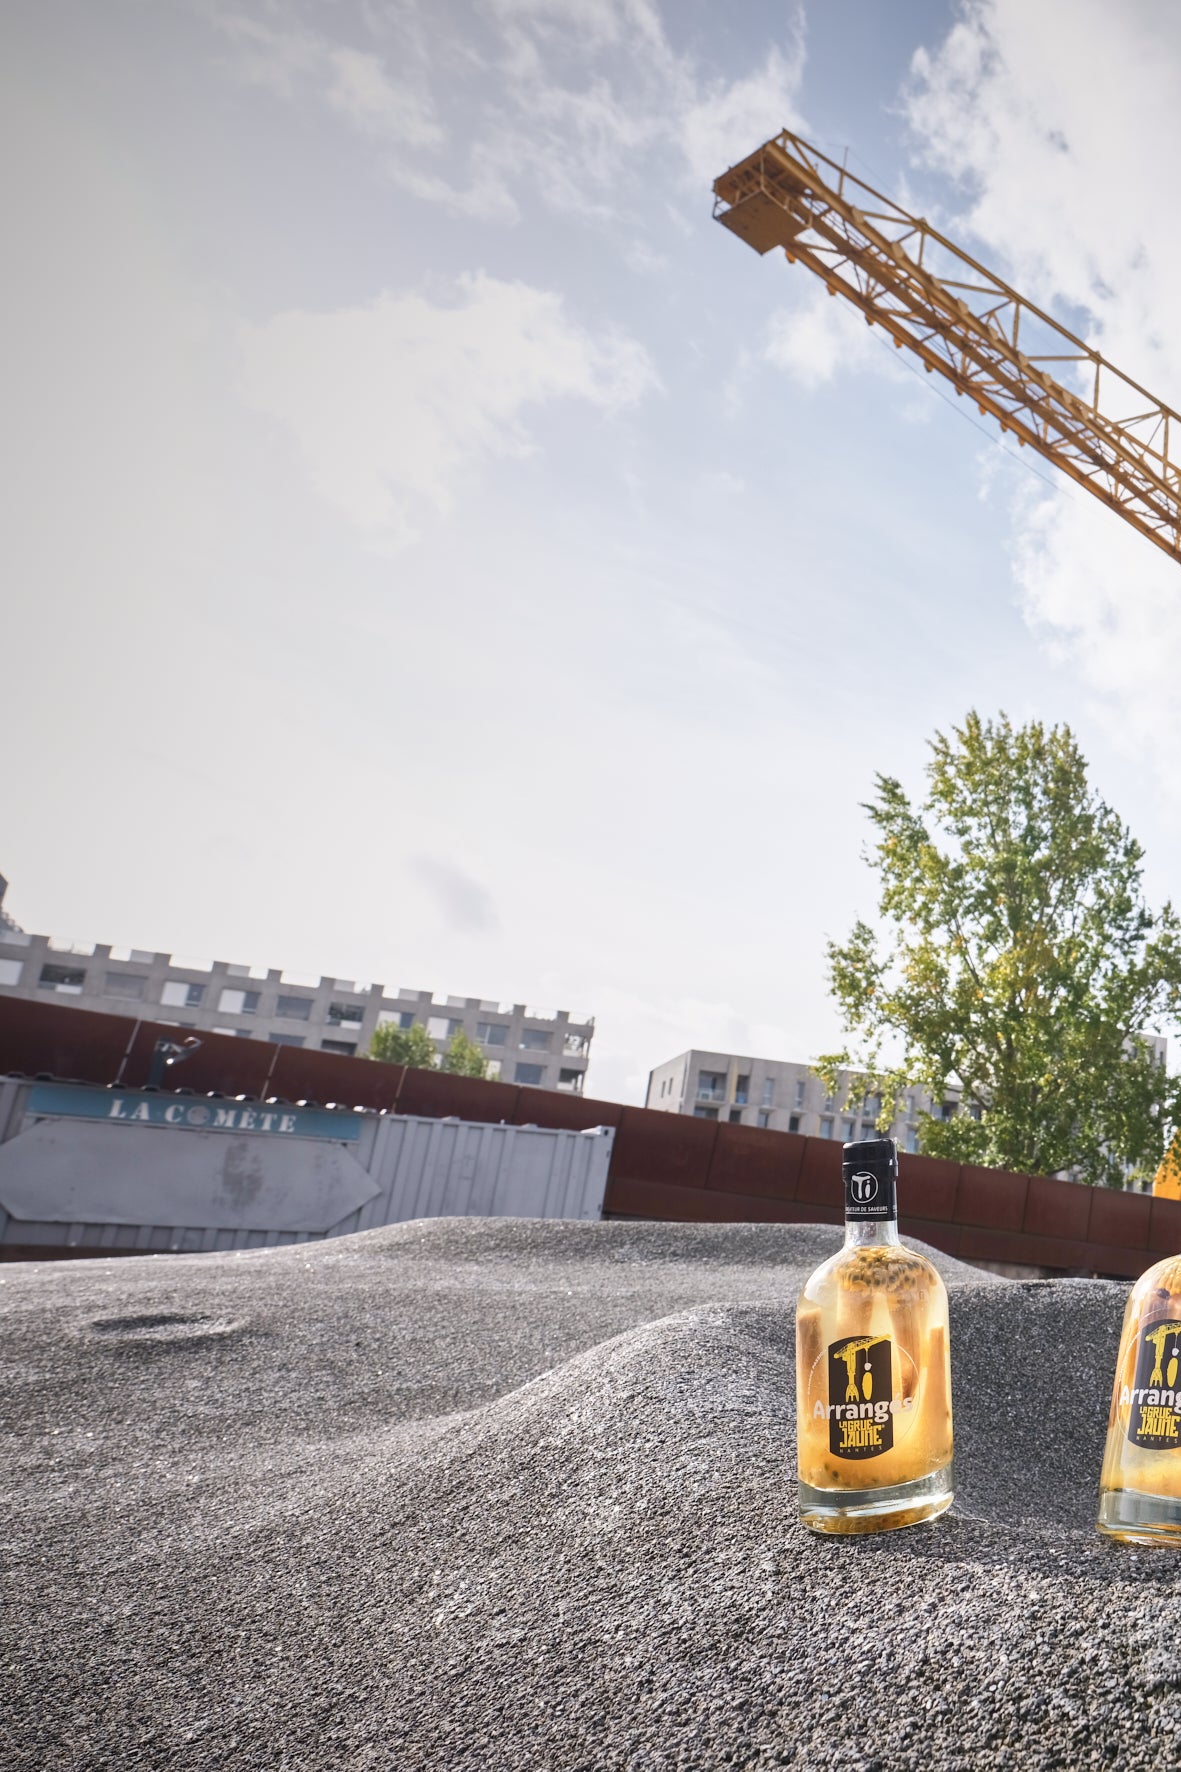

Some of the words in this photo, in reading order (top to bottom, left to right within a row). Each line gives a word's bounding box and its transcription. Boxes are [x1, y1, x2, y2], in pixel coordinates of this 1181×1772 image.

[108, 1099, 150, 1120] LA
[813, 1393, 914, 1423] Arrangés
[1147, 1406, 1172, 1419] GRUE
[847, 1419, 873, 1432] GRUE
[1136, 1436, 1178, 1444] NANTES
